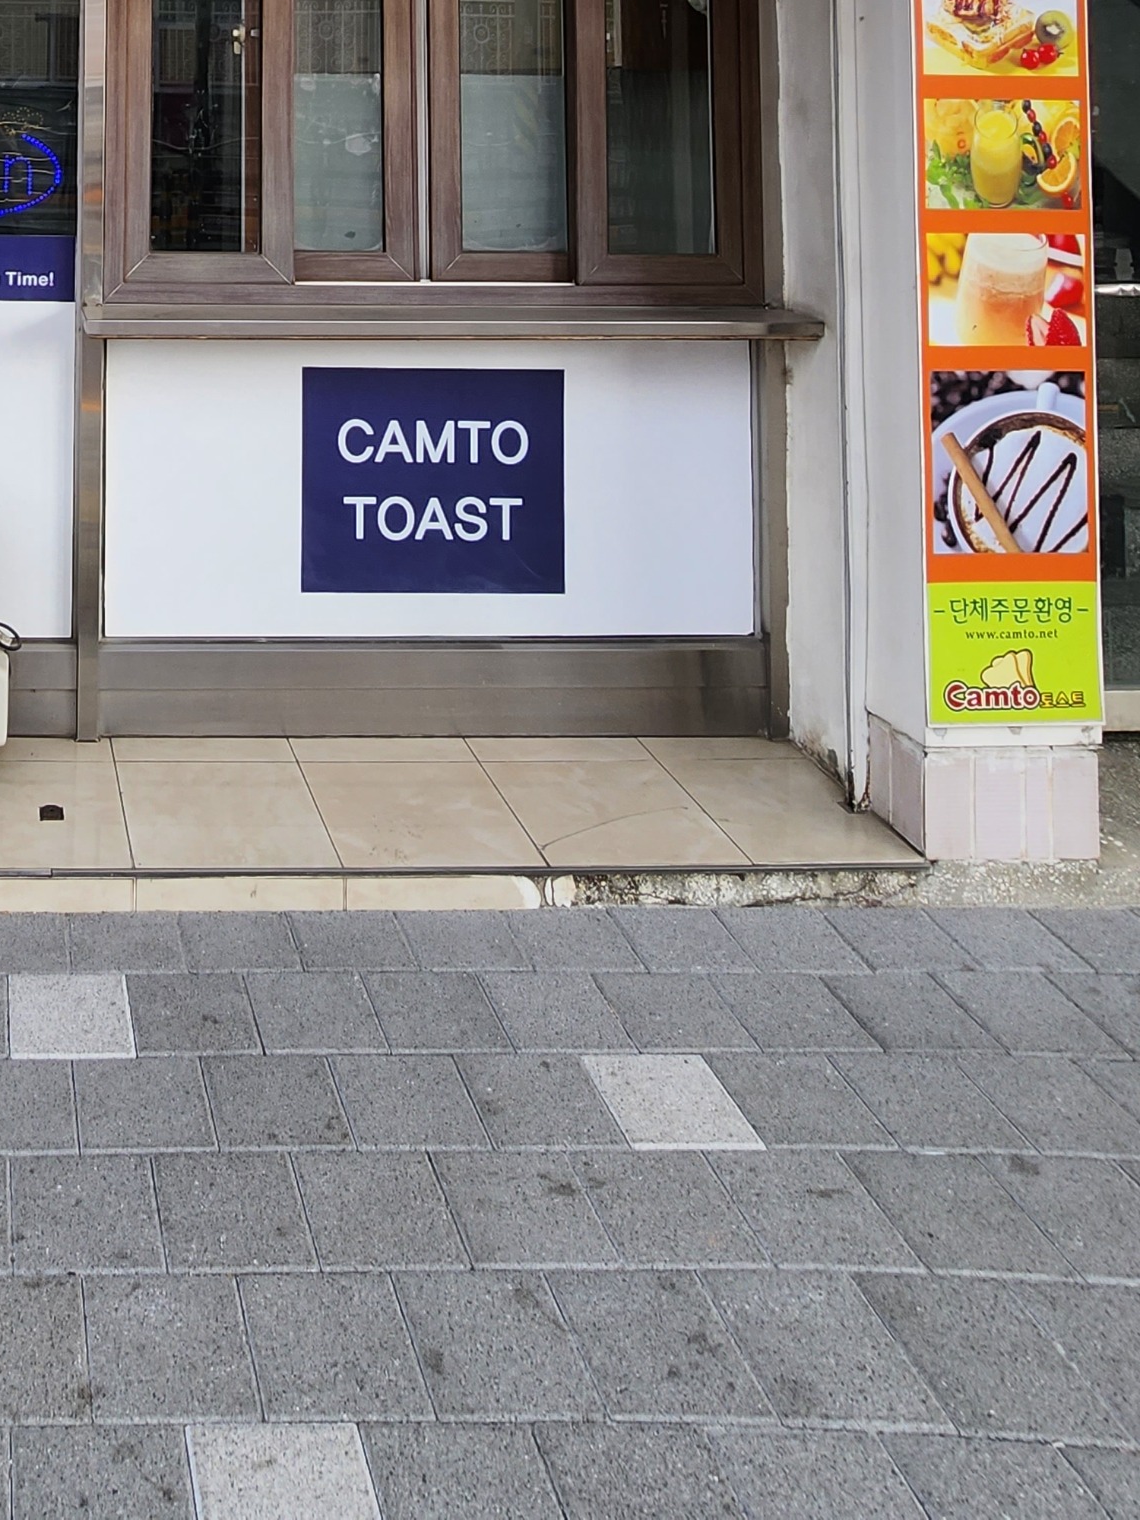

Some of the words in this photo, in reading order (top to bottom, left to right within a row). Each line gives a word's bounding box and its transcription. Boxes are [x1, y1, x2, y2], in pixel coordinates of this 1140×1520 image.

[5, 271, 55, 286] Time!
[337, 418, 529, 465] CAMTO
[343, 496, 523, 541] TOAST
[965, 629, 1059, 640] www.camto.net
